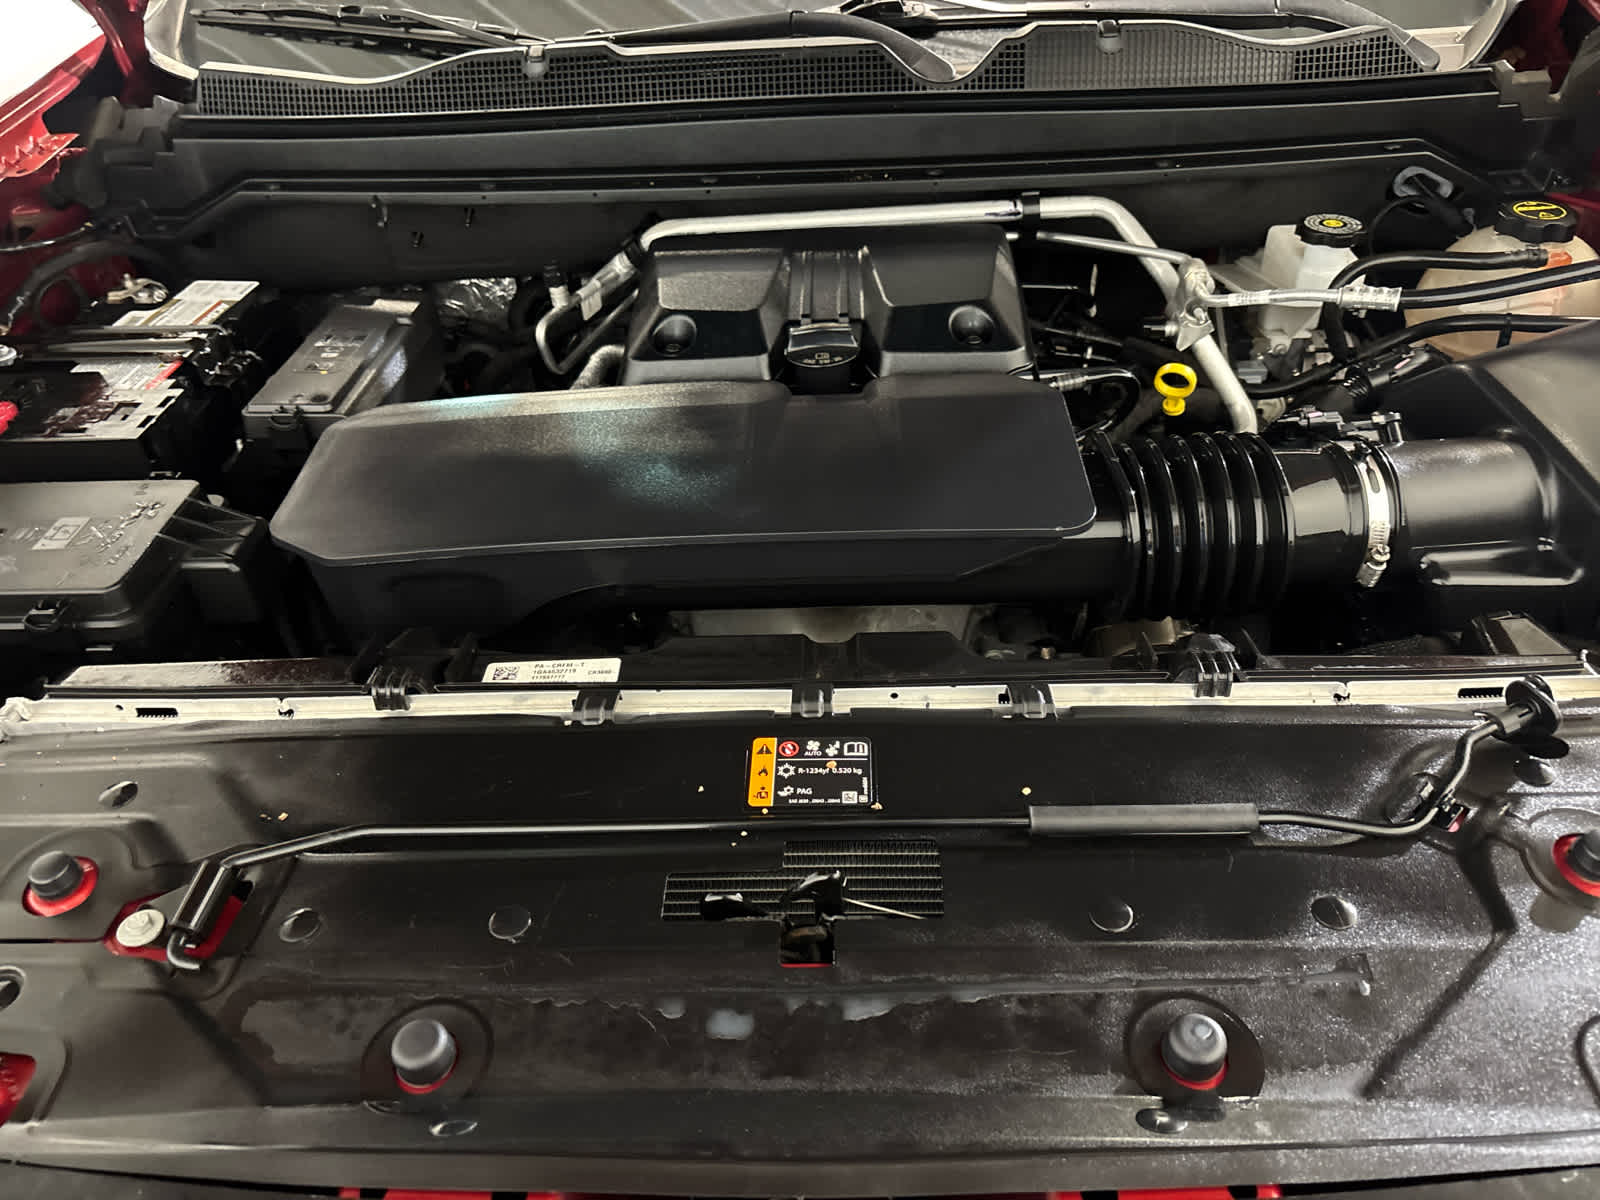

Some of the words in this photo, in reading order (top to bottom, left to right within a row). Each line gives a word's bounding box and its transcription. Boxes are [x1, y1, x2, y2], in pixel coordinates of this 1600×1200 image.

[798, 767, 830, 775] R-1234yf
[853, 767, 863, 775] kg
[796, 787, 812, 795] PAG
